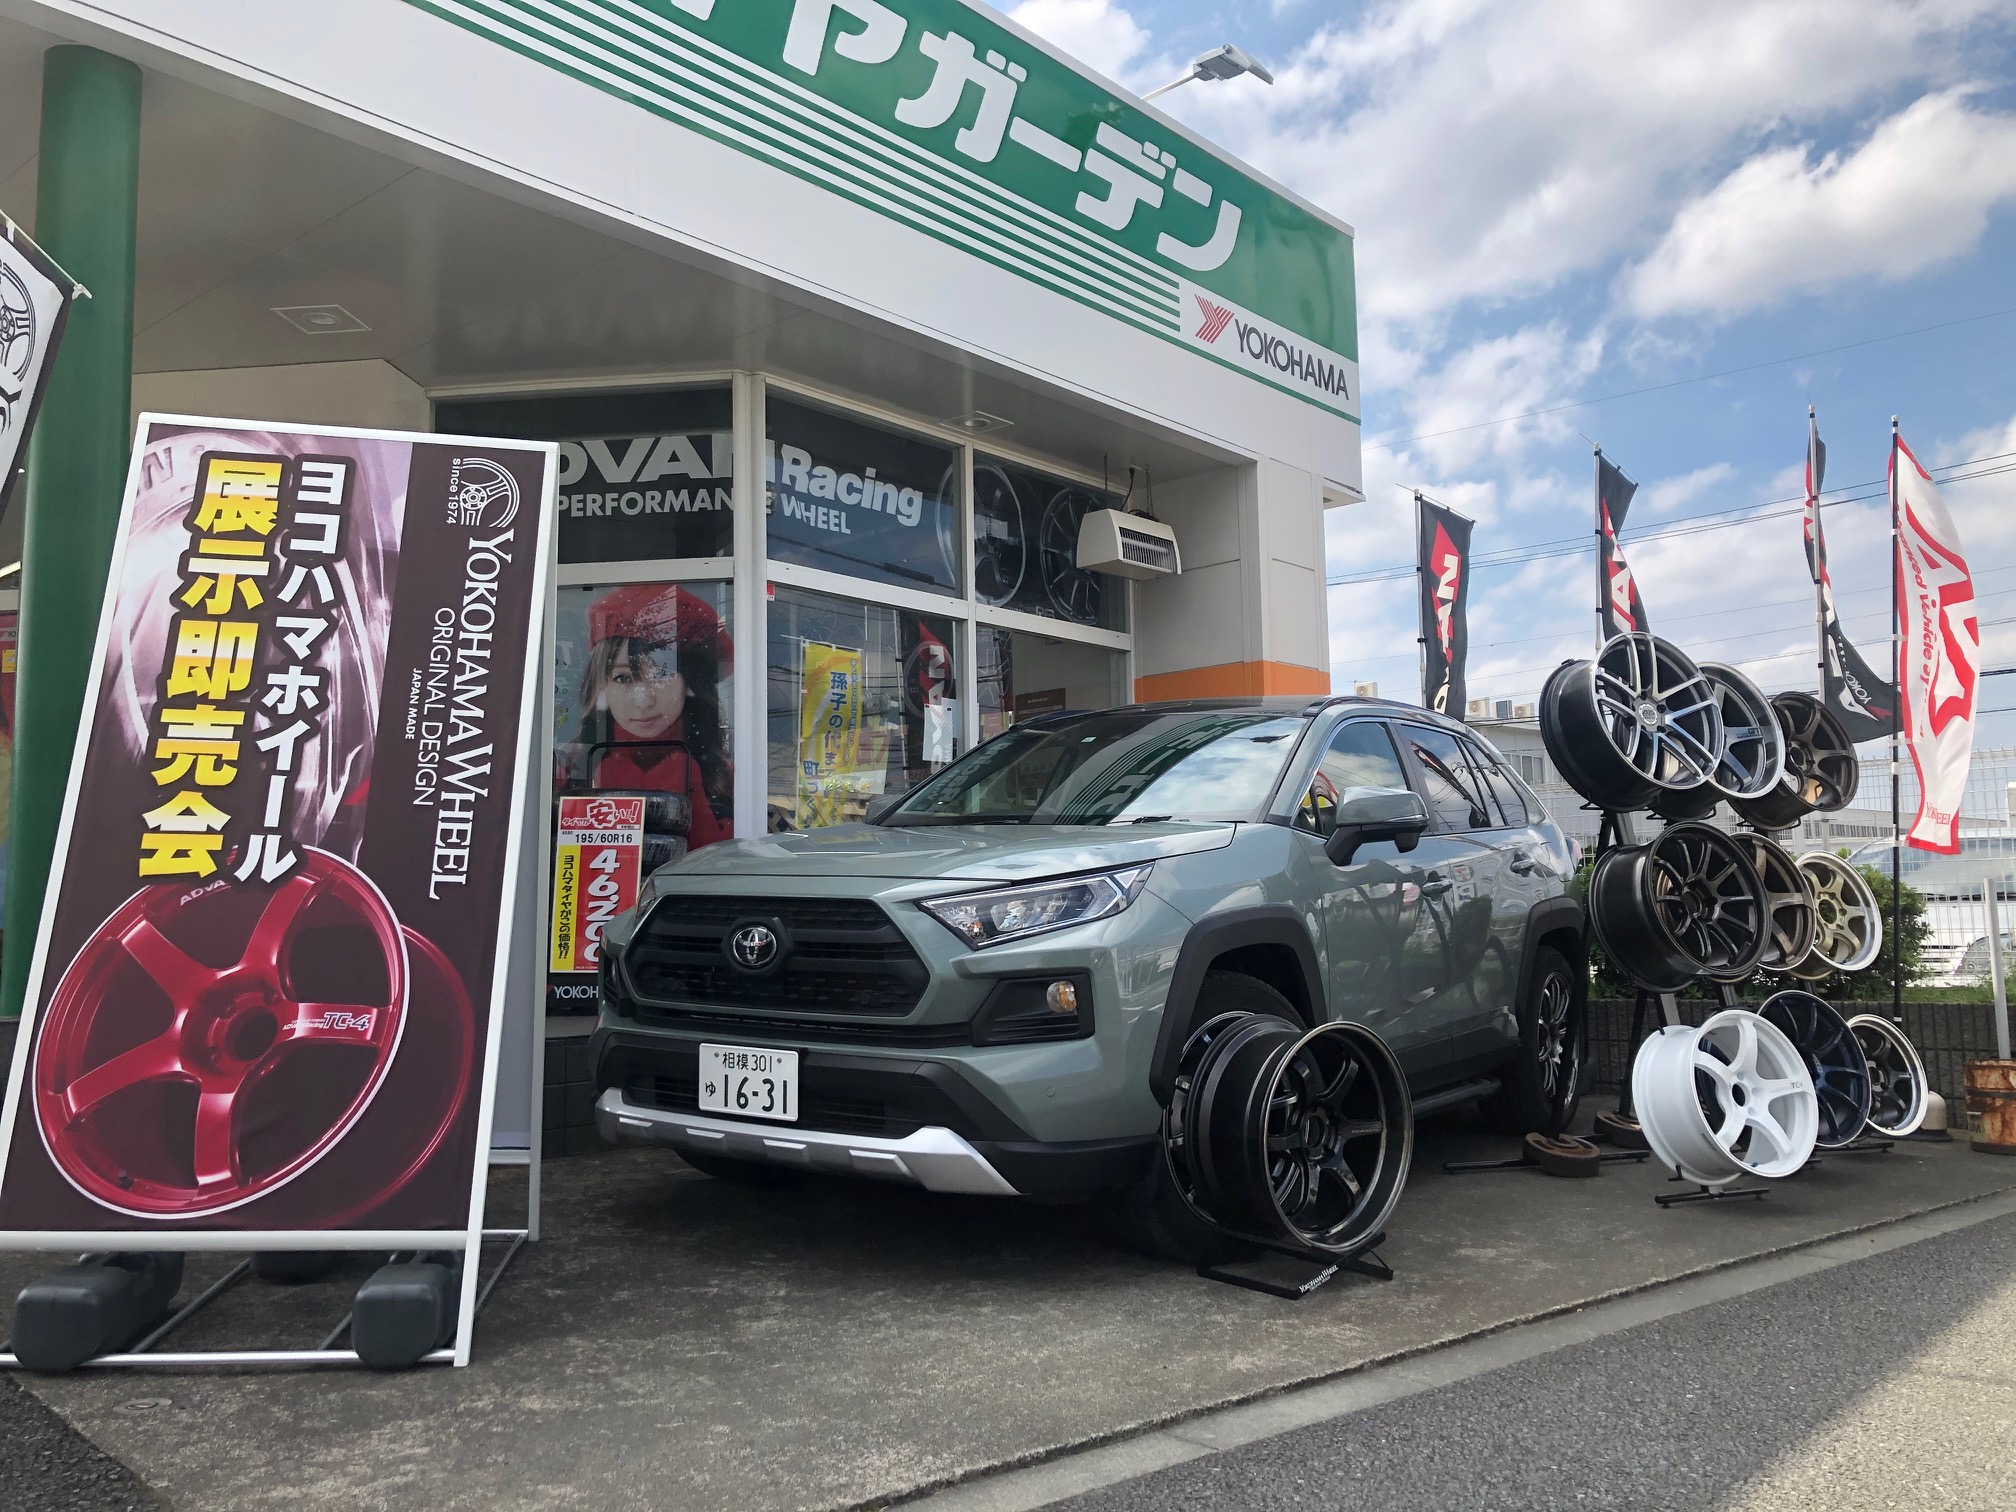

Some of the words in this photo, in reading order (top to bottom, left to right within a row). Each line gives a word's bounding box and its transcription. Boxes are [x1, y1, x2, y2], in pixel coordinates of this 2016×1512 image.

[672, 0, 1242, 271] ヤガーデン
[1235, 318, 1350, 401] YOKOHAMA
[781, 444, 923, 527] Racing
[446, 495, 459, 525] 1974
[780, 493, 851, 535] WHEEL
[138, 457, 284, 879] 展示即売会
[233, 460, 347, 884] ヨコハマホイール
[423, 607, 456, 716] ORIGINAL
[410, 667, 423, 705] JAPAN
[405, 706, 418, 740] MADE
[413, 721, 443, 807] DESIGN
[575, 833, 633, 844] 195/60R16
[180, 879, 227, 907] ADVA
[554, 985, 599, 999] YOKOH
[323, 1012, 373, 1031] TC-4
[705, 1080, 717, 1098] ゆ
[724, 1073, 788, 1115] 16-31
